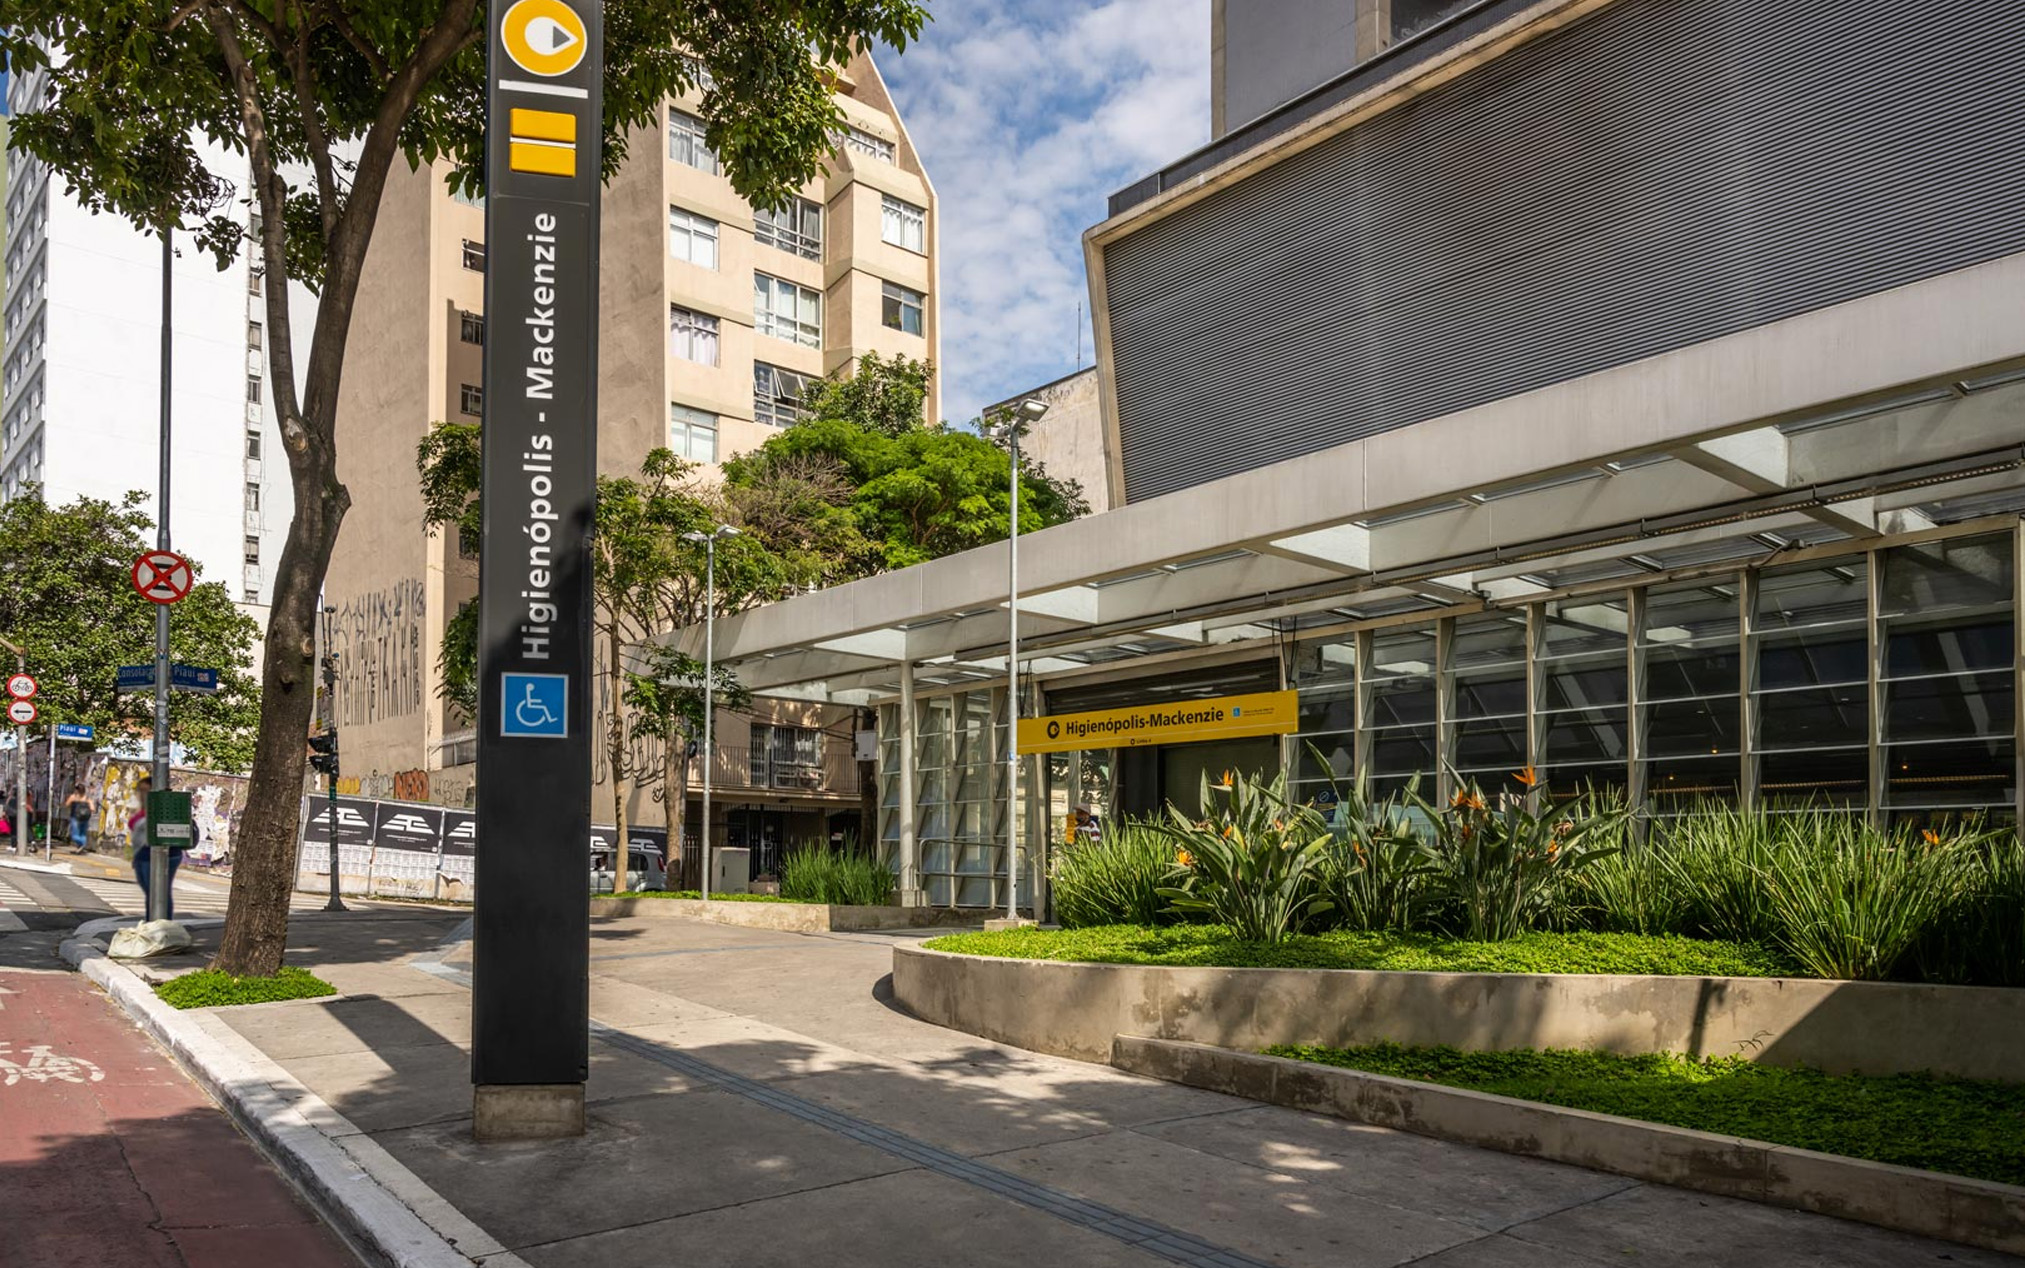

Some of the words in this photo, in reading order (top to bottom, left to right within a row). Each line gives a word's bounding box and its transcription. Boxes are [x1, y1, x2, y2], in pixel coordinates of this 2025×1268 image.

[525, 211, 557, 400] Mackenzie
[521, 434, 559, 659] Higienópolis
[1066, 707, 1224, 737] Higienópolis-Mackenzie
